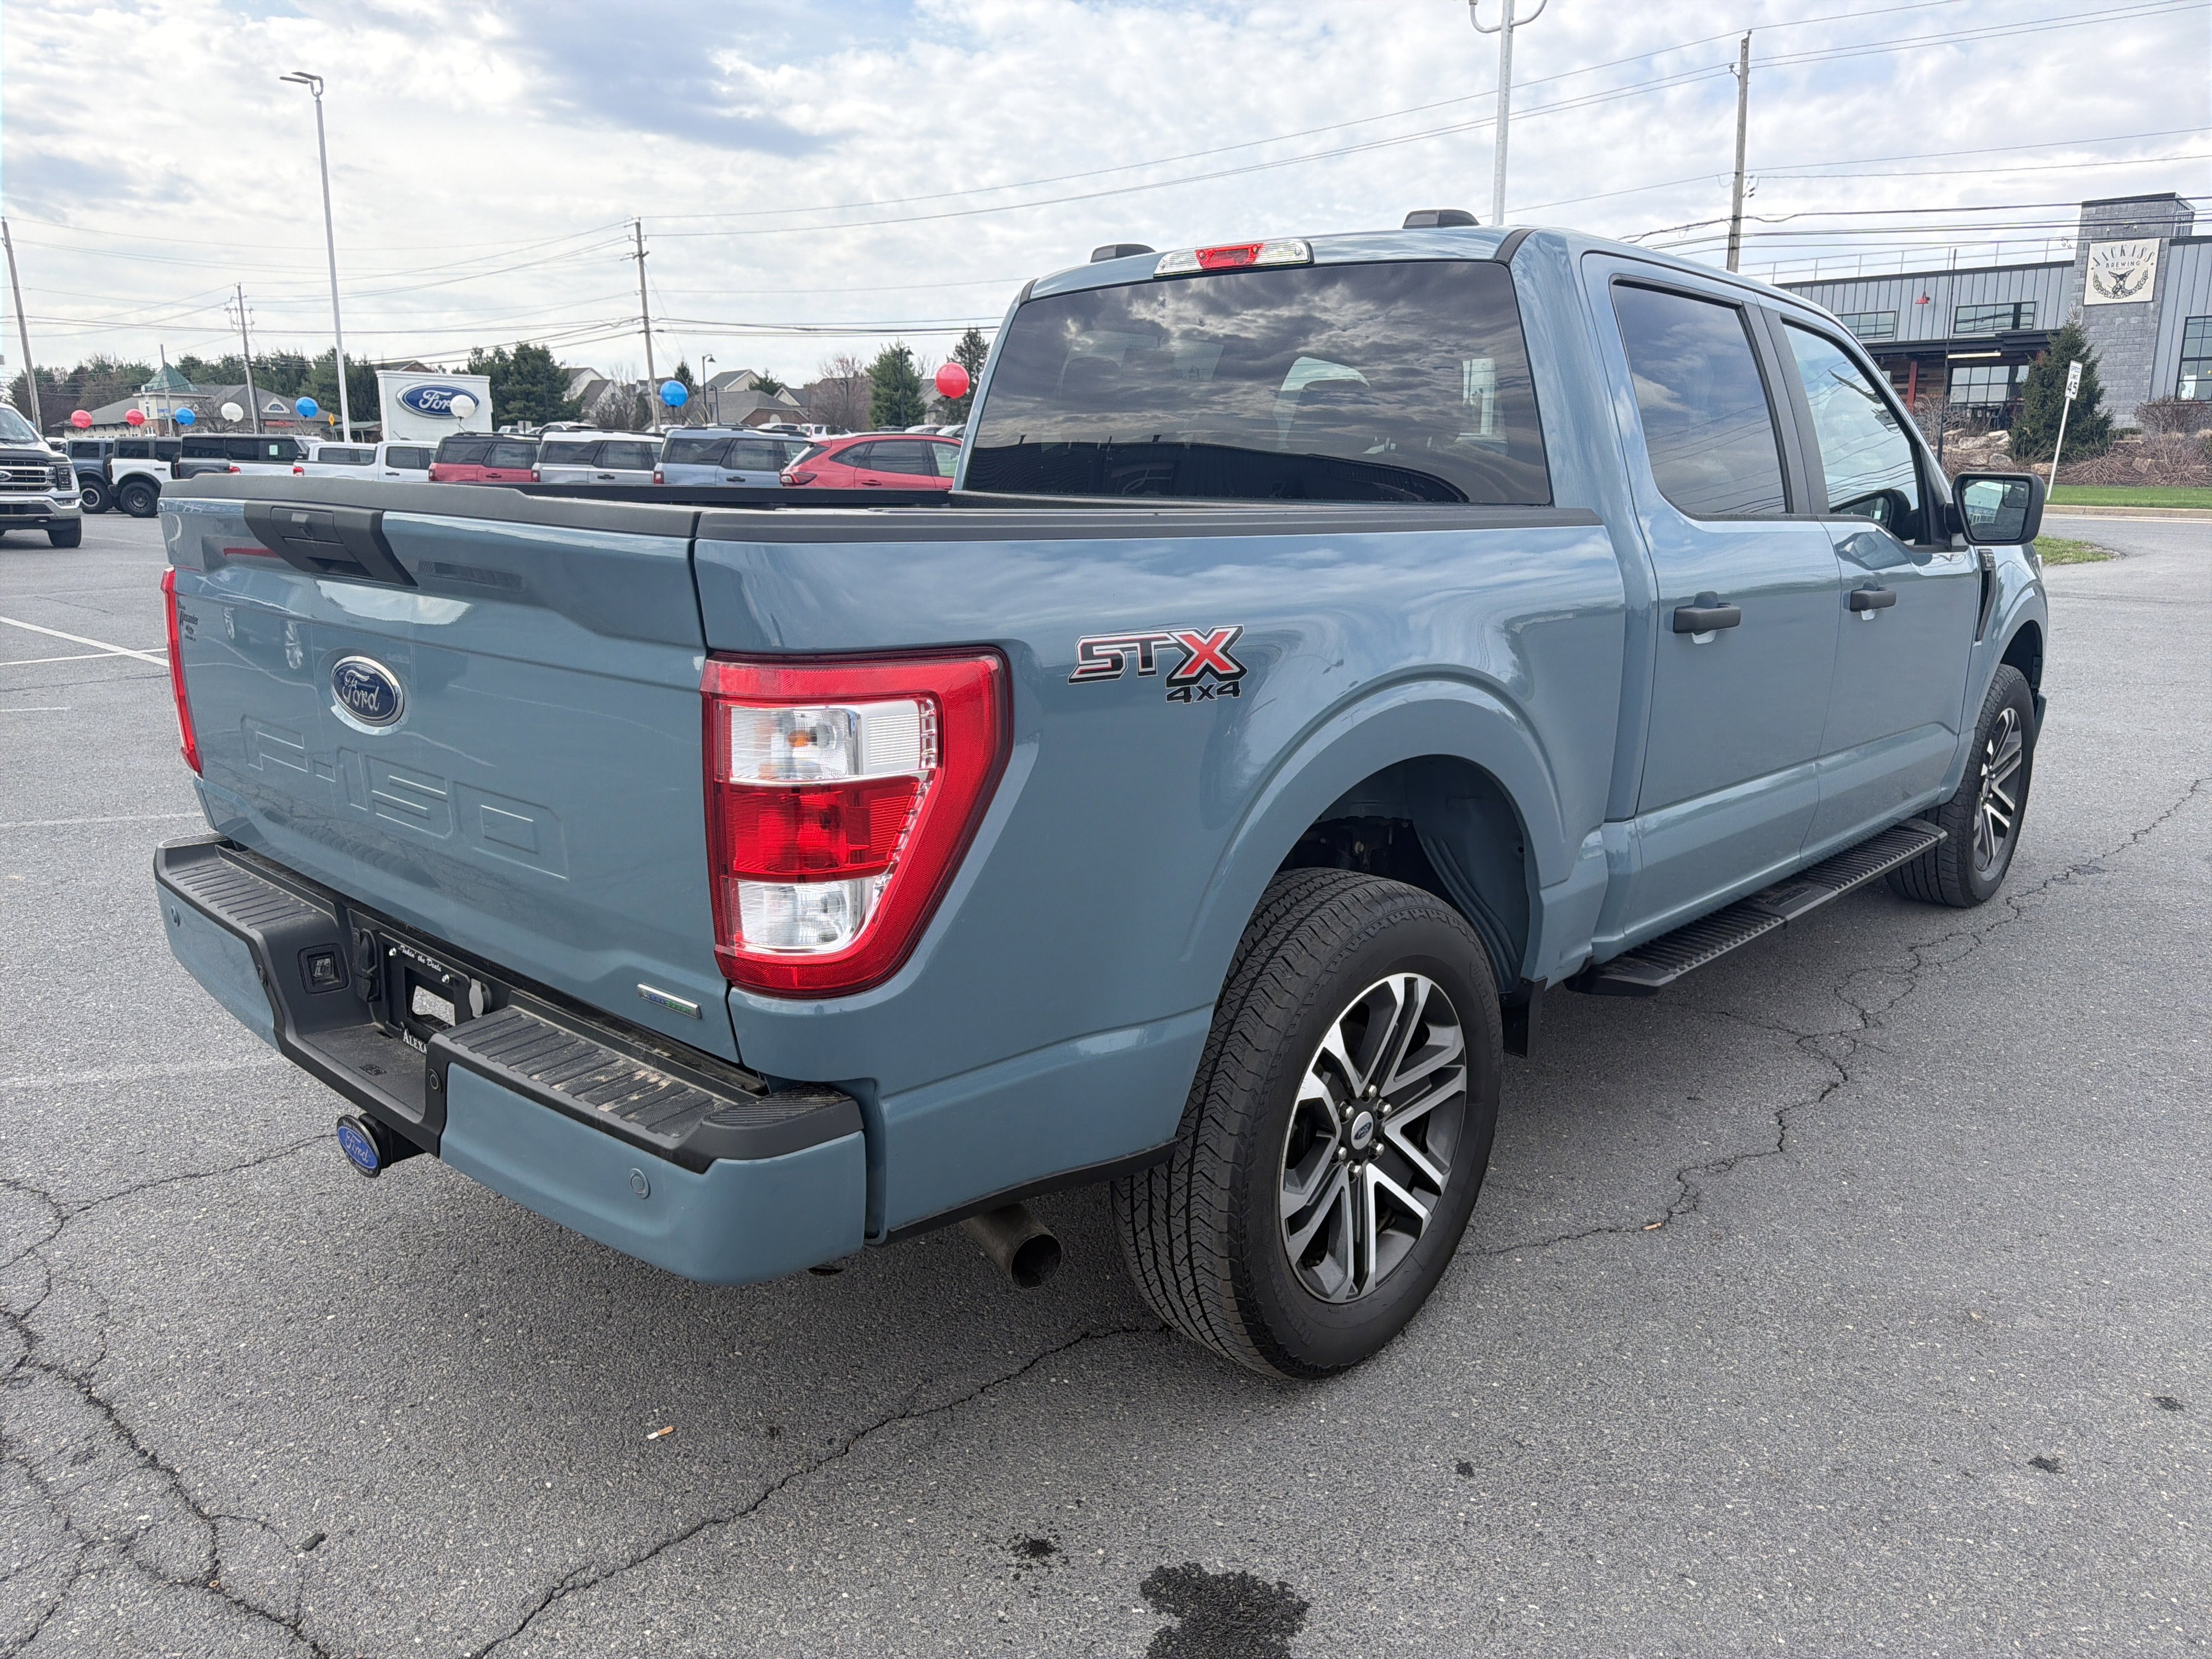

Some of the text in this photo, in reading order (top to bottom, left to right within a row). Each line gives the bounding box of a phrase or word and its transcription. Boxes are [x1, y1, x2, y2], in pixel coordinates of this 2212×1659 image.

[419, 390, 452, 410] For
[2067, 381, 2078, 394] 45
[1068, 624, 1248, 689] STX
[342, 669, 380, 712] Ford
[417, 955, 426, 964] the
[427, 958, 442, 972] Deals
[345, 1130, 369, 1163] Ford
